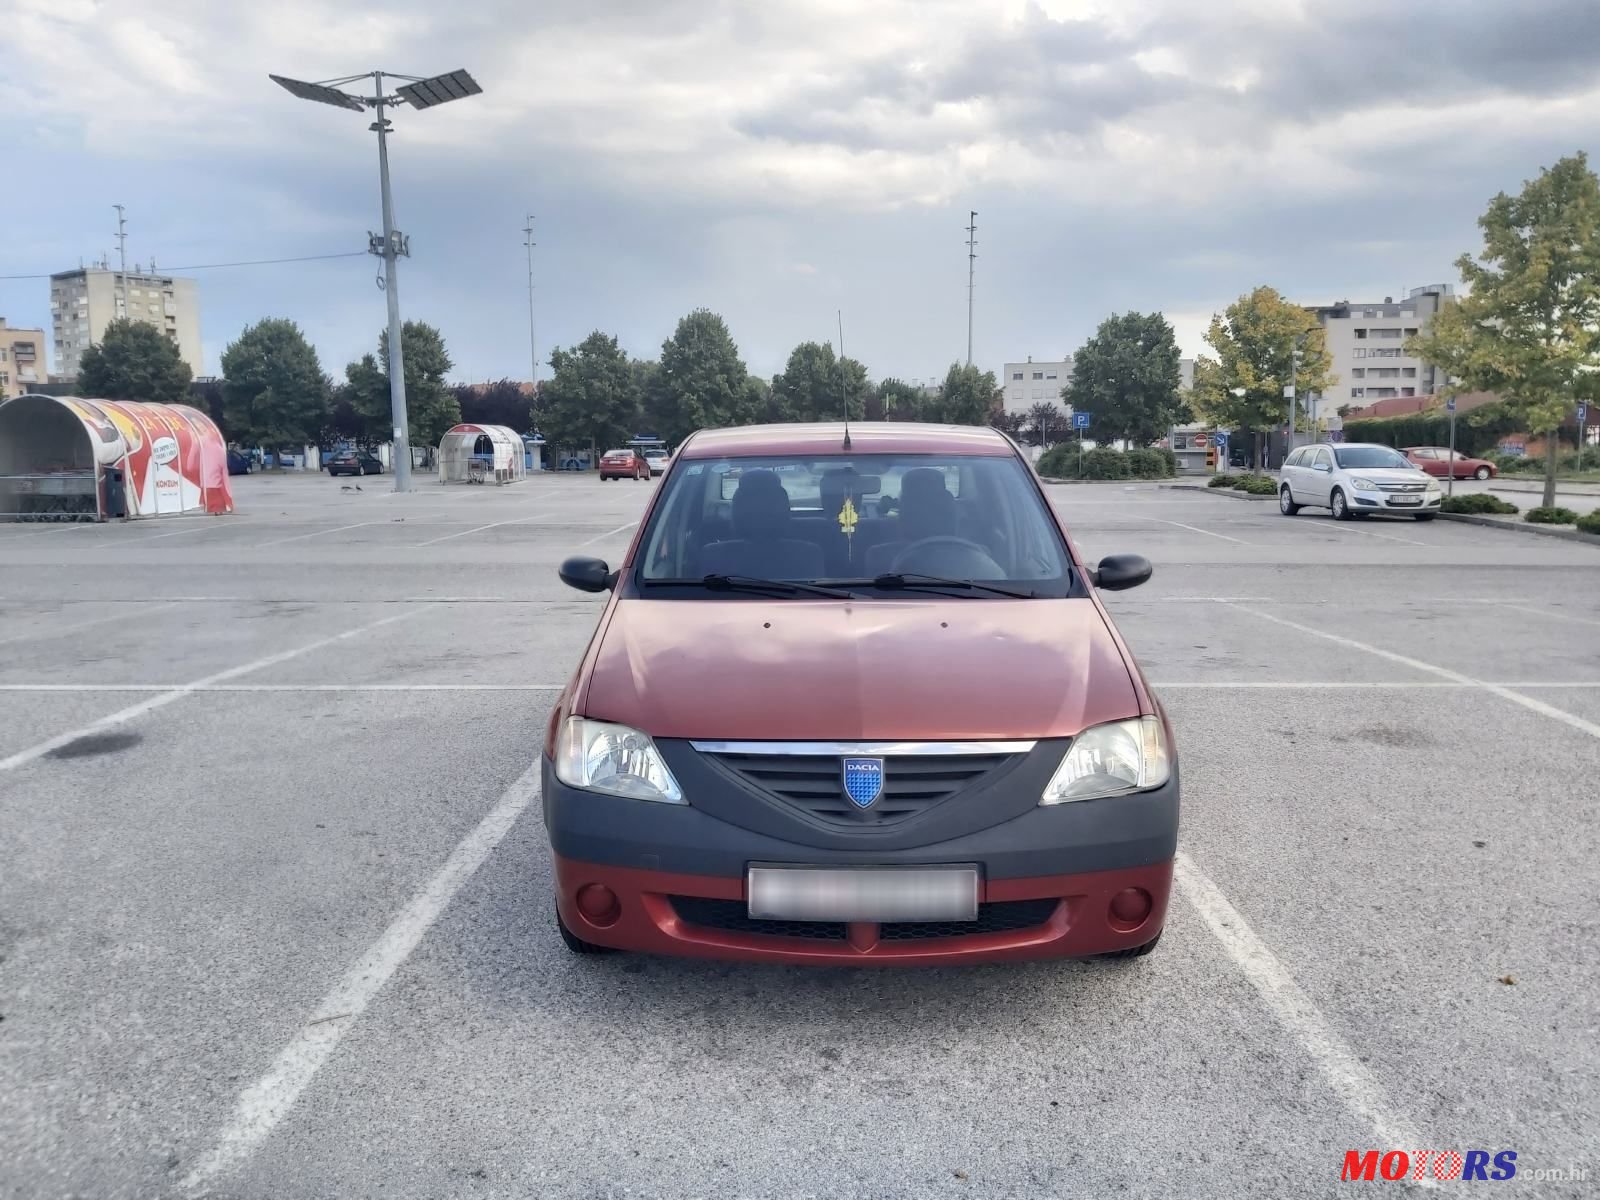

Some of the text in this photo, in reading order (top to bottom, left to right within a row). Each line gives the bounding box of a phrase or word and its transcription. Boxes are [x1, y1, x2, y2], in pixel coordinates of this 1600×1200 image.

[1578, 407, 1584, 419] P
[1077, 415, 1085, 426] P
[155, 479, 179, 489] KONZUM
